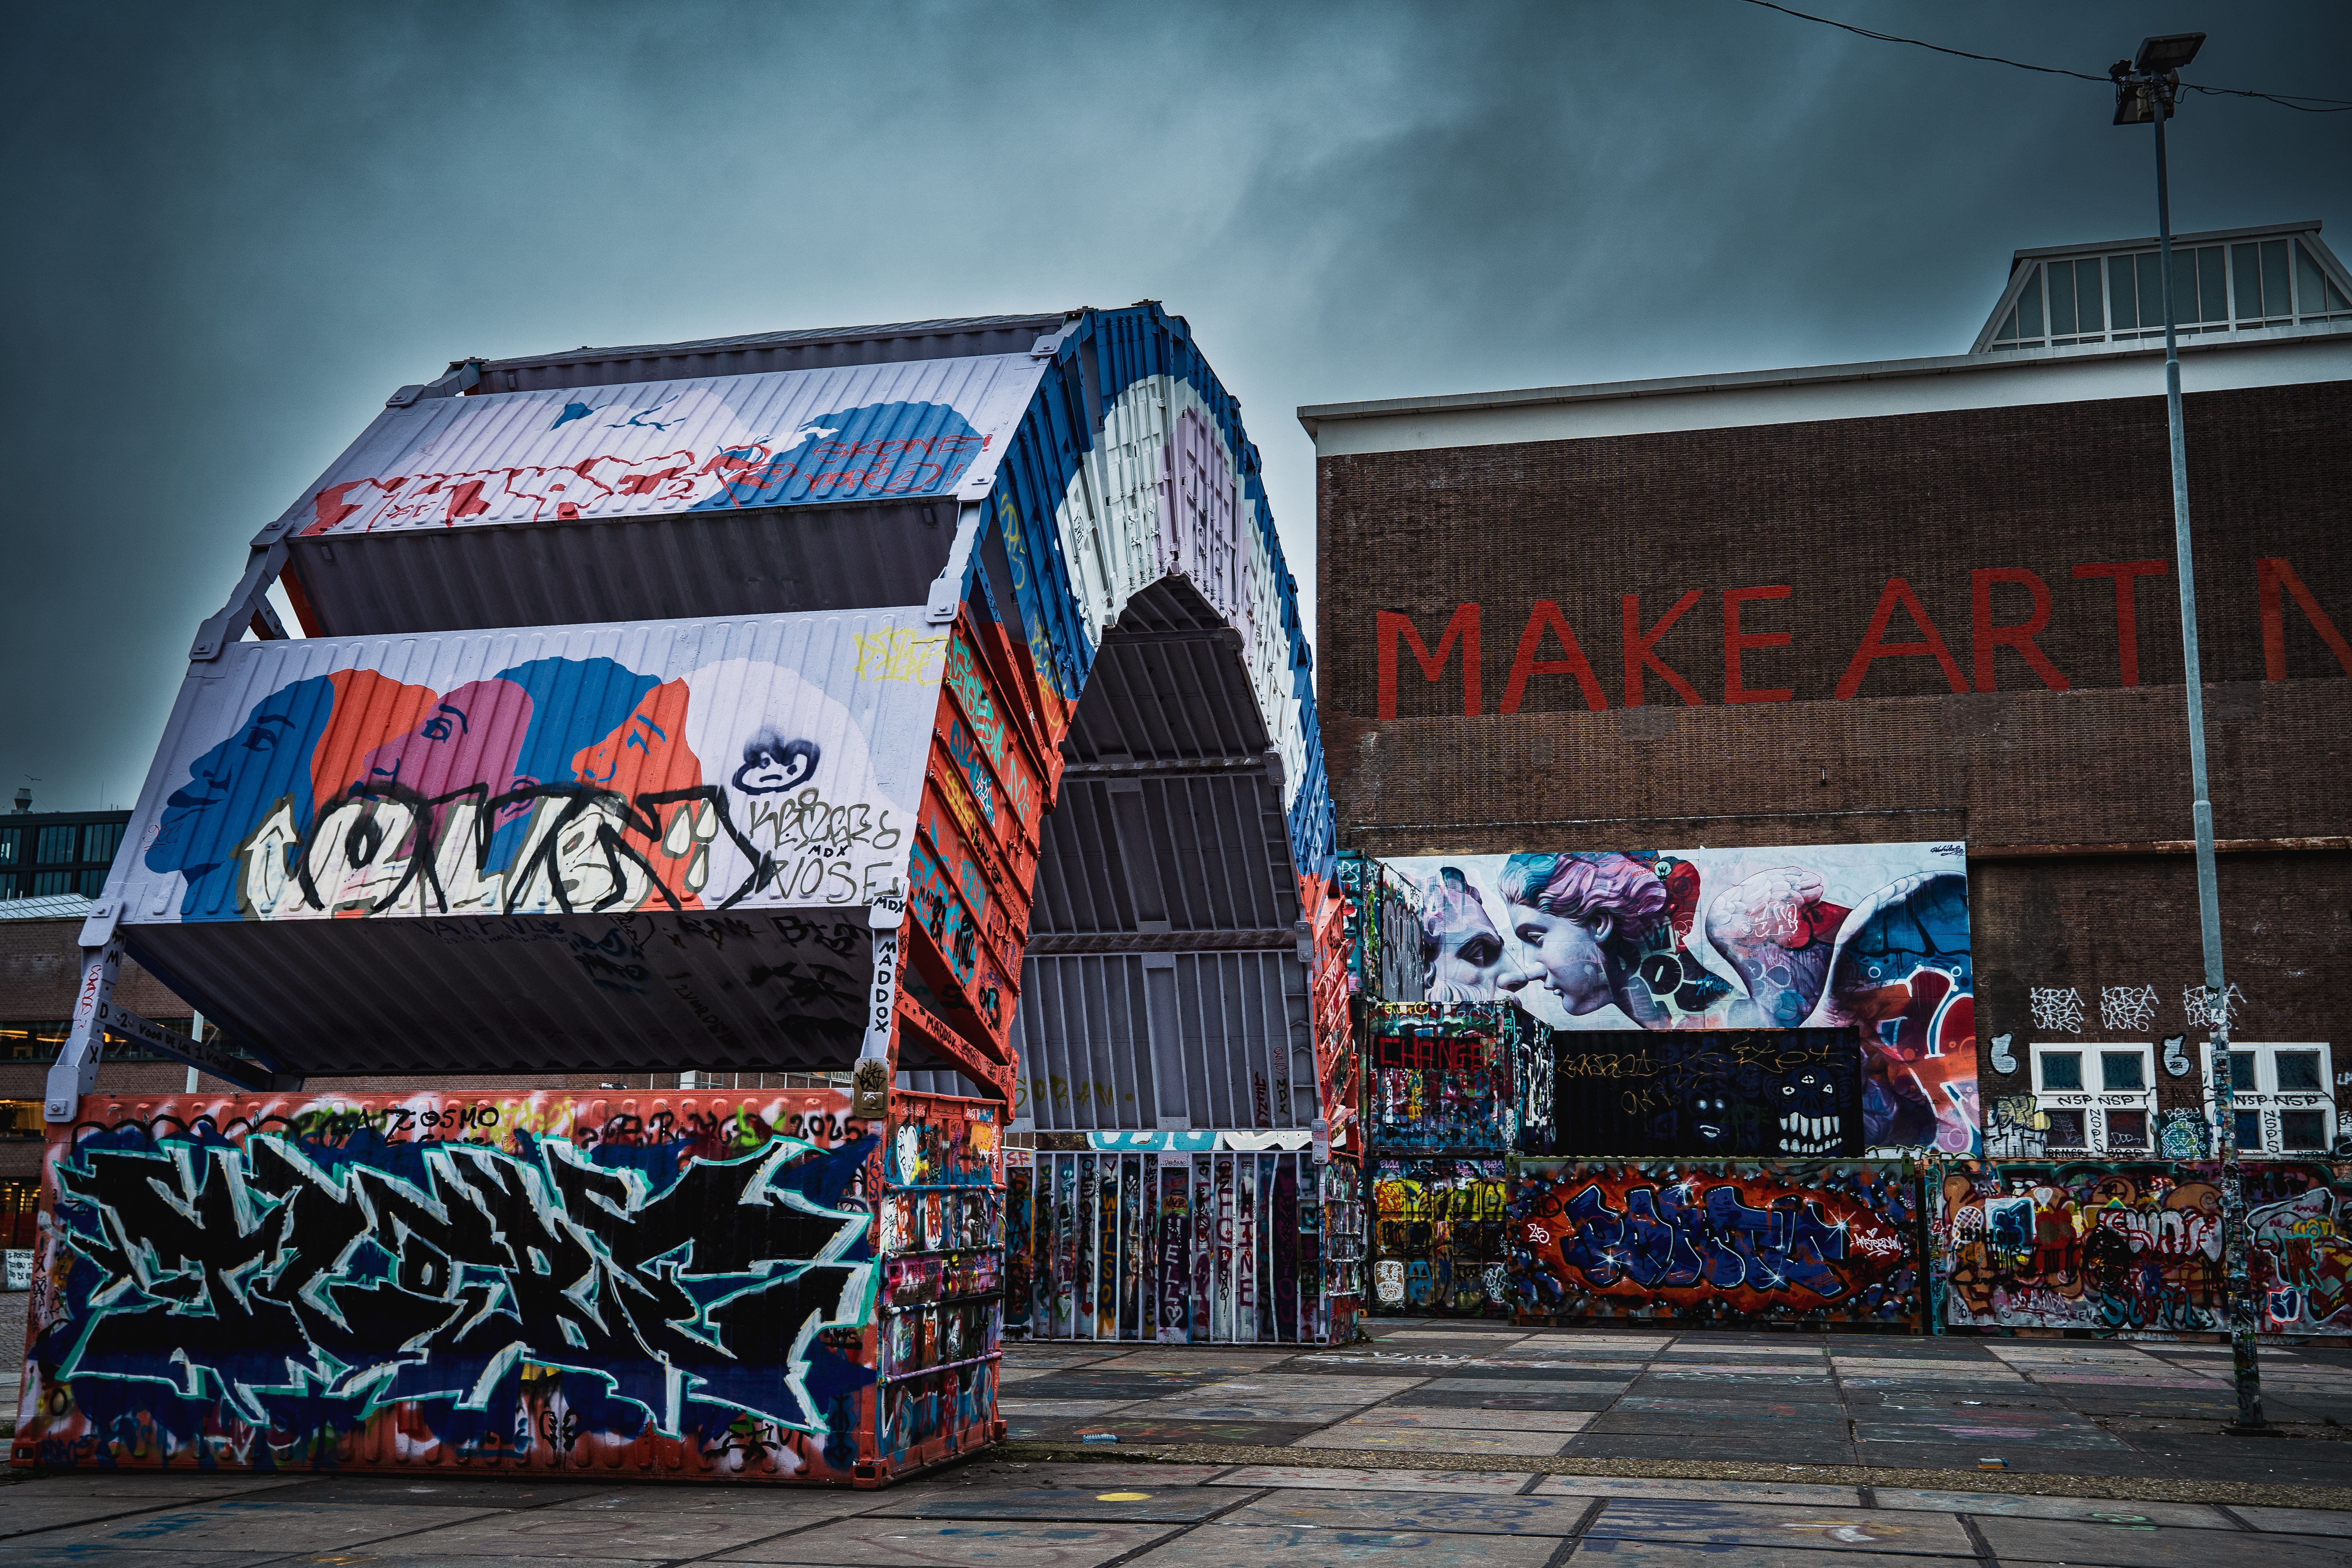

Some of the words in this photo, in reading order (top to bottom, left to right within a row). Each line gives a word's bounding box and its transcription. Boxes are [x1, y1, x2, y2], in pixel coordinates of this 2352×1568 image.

[1377, 585, 1792, 721] MAKE
[1835, 559, 2169, 702] ART
[874, 941, 897, 1033] MADDOX
[139, 1023, 162, 1041] VOOR
[165, 1031, 176, 1049] DE
[177, 1040, 191, 1056] LOL
[195, 1046, 204, 1061] 1
[1378, 1035, 1483, 1070] CHANGE
[2058, 1095, 2094, 1106] NSP
[2098, 1095, 2135, 1105] NSP
[2274, 1095, 2319, 1106] NSP
[1098, 1193, 1118, 1332] WILSON
